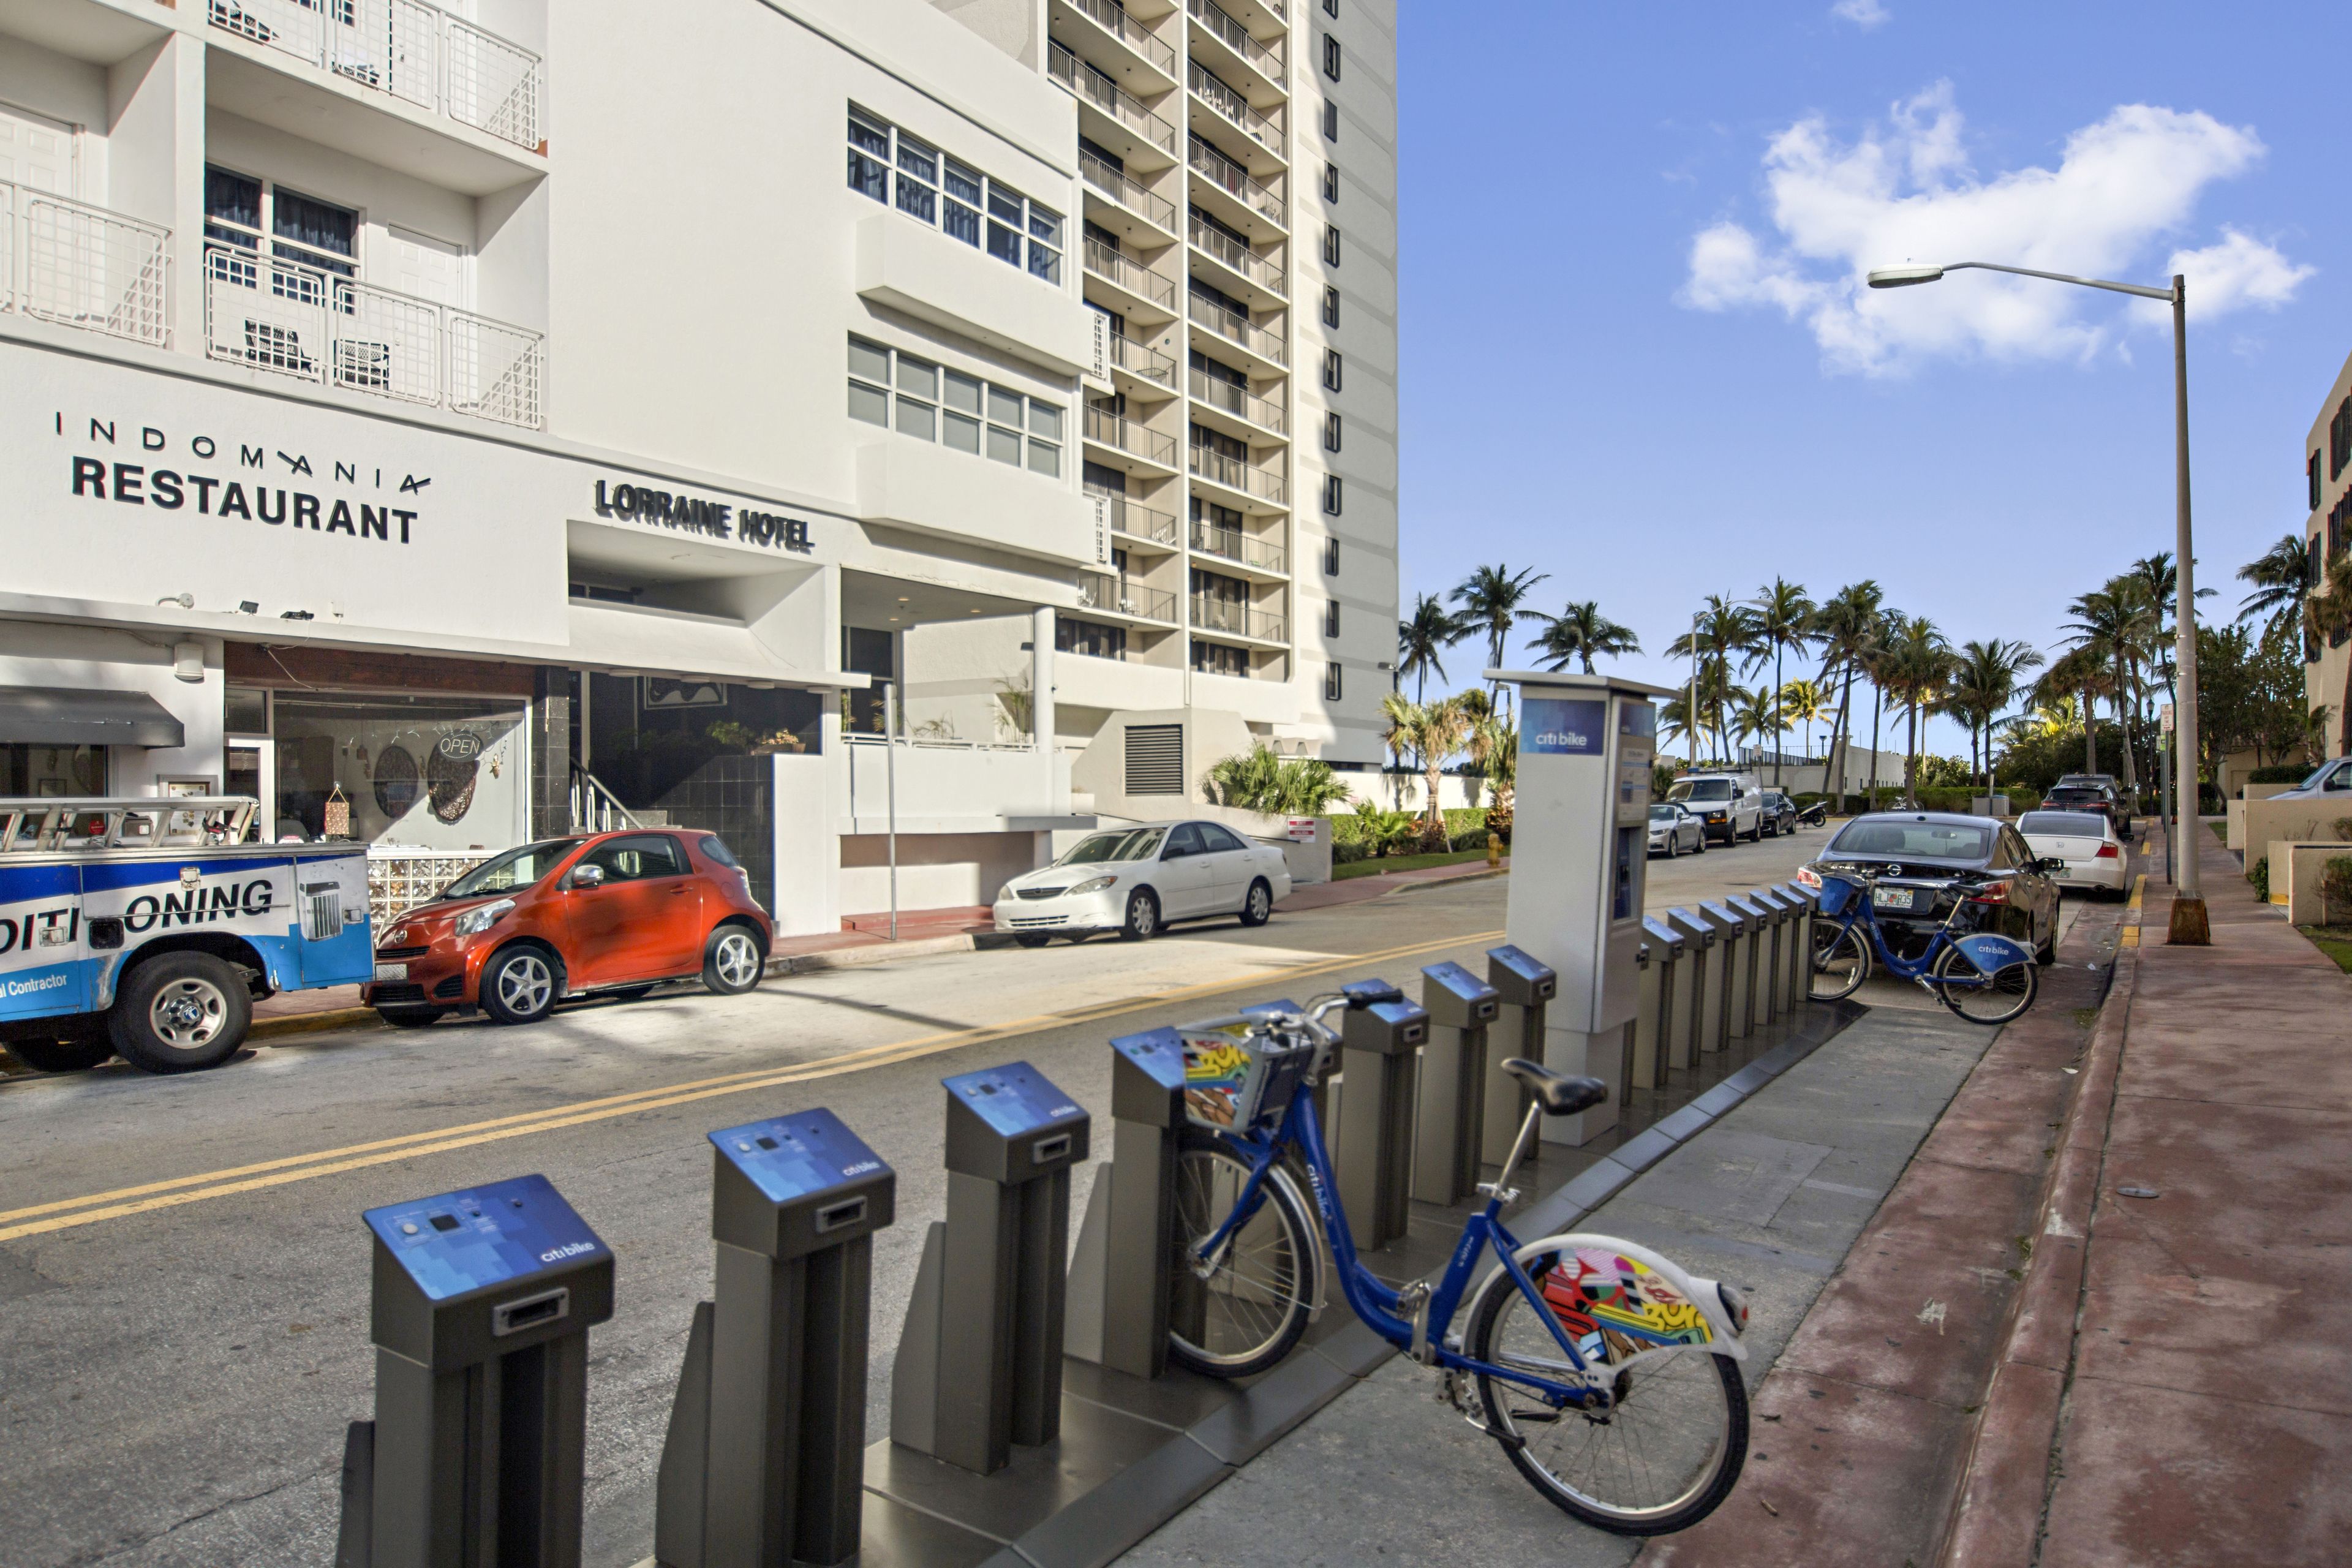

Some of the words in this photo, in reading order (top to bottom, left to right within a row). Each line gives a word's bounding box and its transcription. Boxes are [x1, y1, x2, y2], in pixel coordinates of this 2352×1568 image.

[56, 411, 431, 495] INDOMANIA
[72, 456, 418, 544] RESTAURANT
[595, 480, 733, 534] LORRAINE
[739, 510, 815, 548] HOTEL
[440, 738, 481, 754] OPEN
[1536, 732, 1556, 745] citi
[1559, 732, 1587, 746] bike
[1992, 946, 2009, 955] bike
[9, 975, 67, 996] Contractor
[541, 1250, 566, 1262] citi
[562, 1243, 595, 1256] bike
